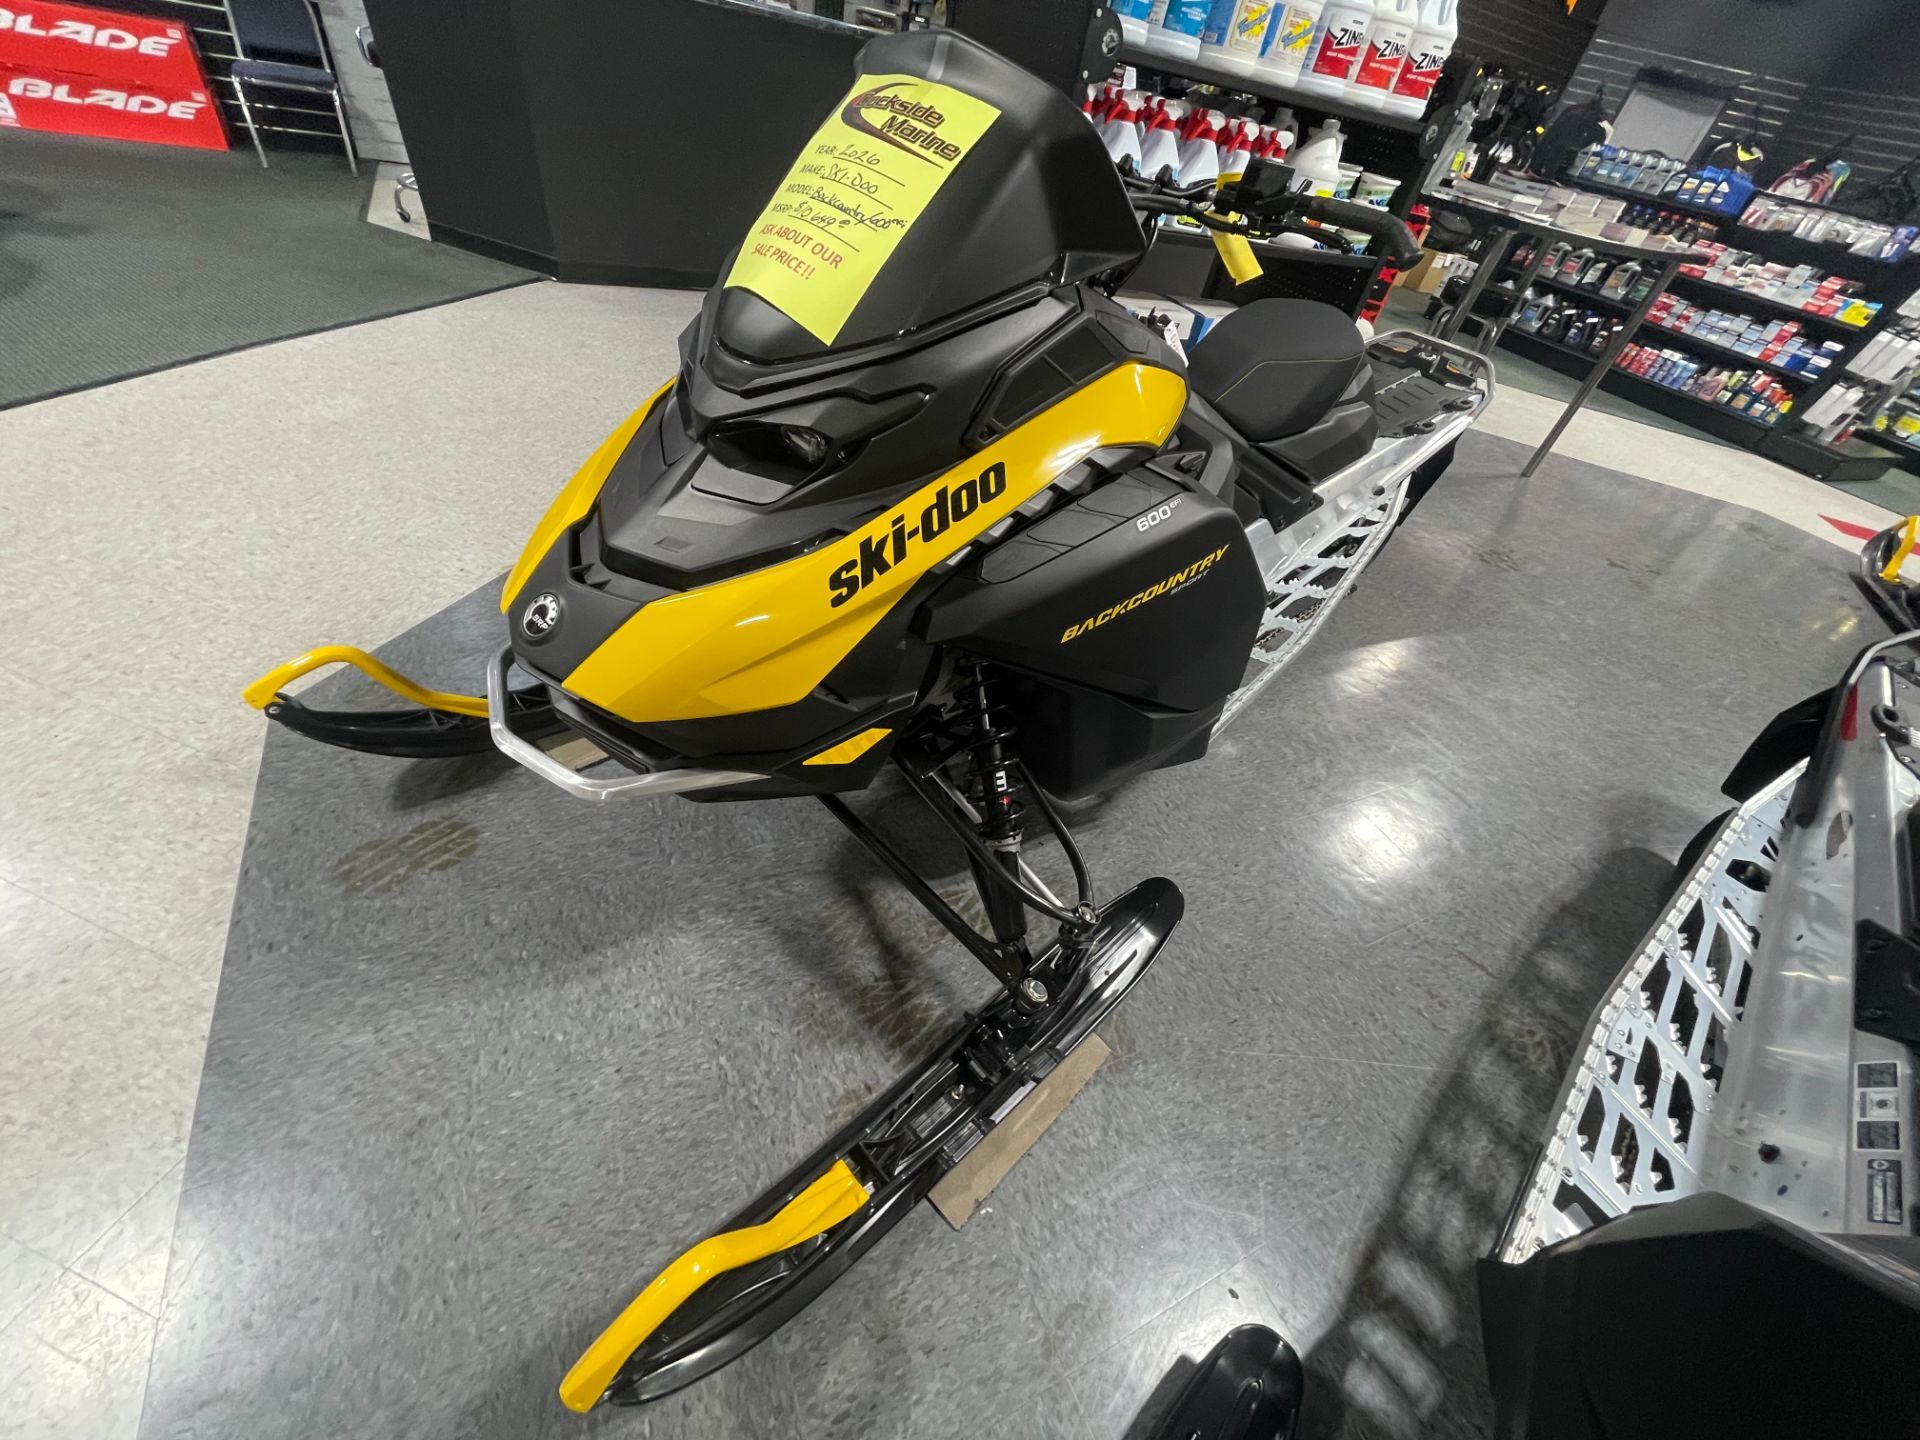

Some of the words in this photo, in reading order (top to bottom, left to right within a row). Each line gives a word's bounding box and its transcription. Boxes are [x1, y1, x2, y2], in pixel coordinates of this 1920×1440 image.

[8, 77, 207, 120] BLADE
[838, 144, 881, 166] 2026
[880, 114, 962, 162] Marine
[752, 243, 773, 257] SALE
[769, 247, 816, 280] PRICE!!
[774, 225, 814, 248] ABOUT
[810, 242, 843, 270] OUR
[829, 461, 1007, 609] ski-doo
[1136, 504, 1171, 532] 600
[1061, 543, 1230, 643] BACKCOUNTRY
[532, 613, 549, 630] BRP
